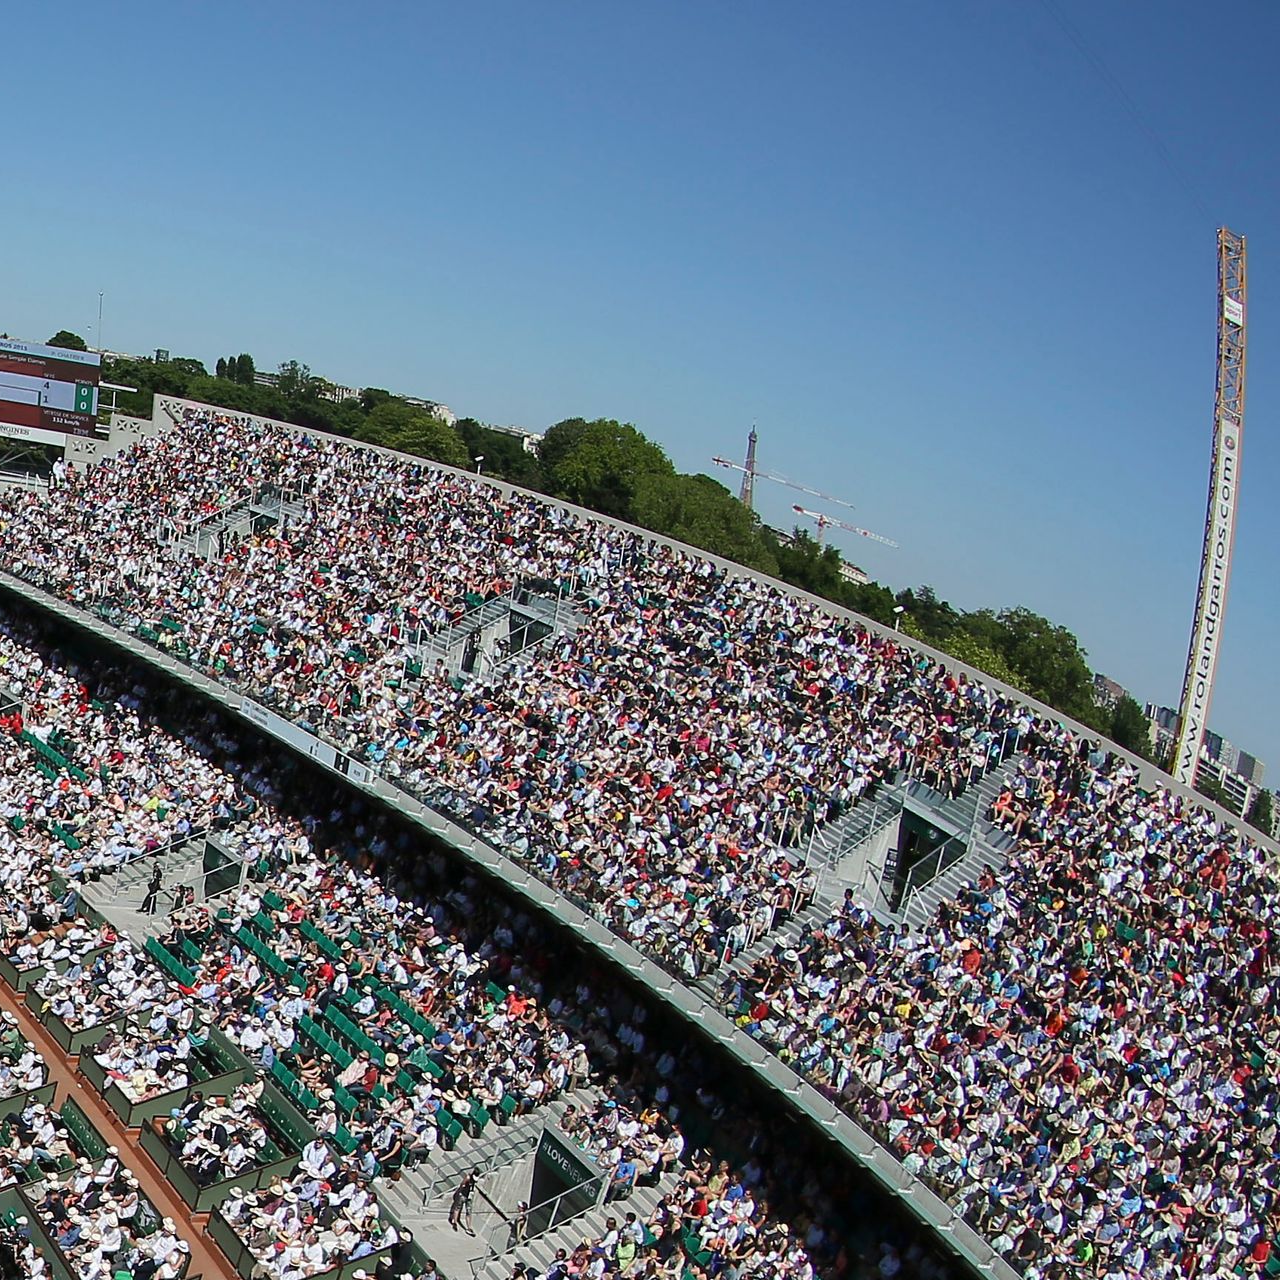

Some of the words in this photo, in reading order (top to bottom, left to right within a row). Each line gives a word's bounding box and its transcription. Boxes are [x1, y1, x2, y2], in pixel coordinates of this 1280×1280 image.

[8, 354, 26, 363] Simple
[44, 381, 50, 389] 4
[81, 388, 88, 396] 0
[43, 395, 48, 403] 1
[80, 402, 87, 410] 0
